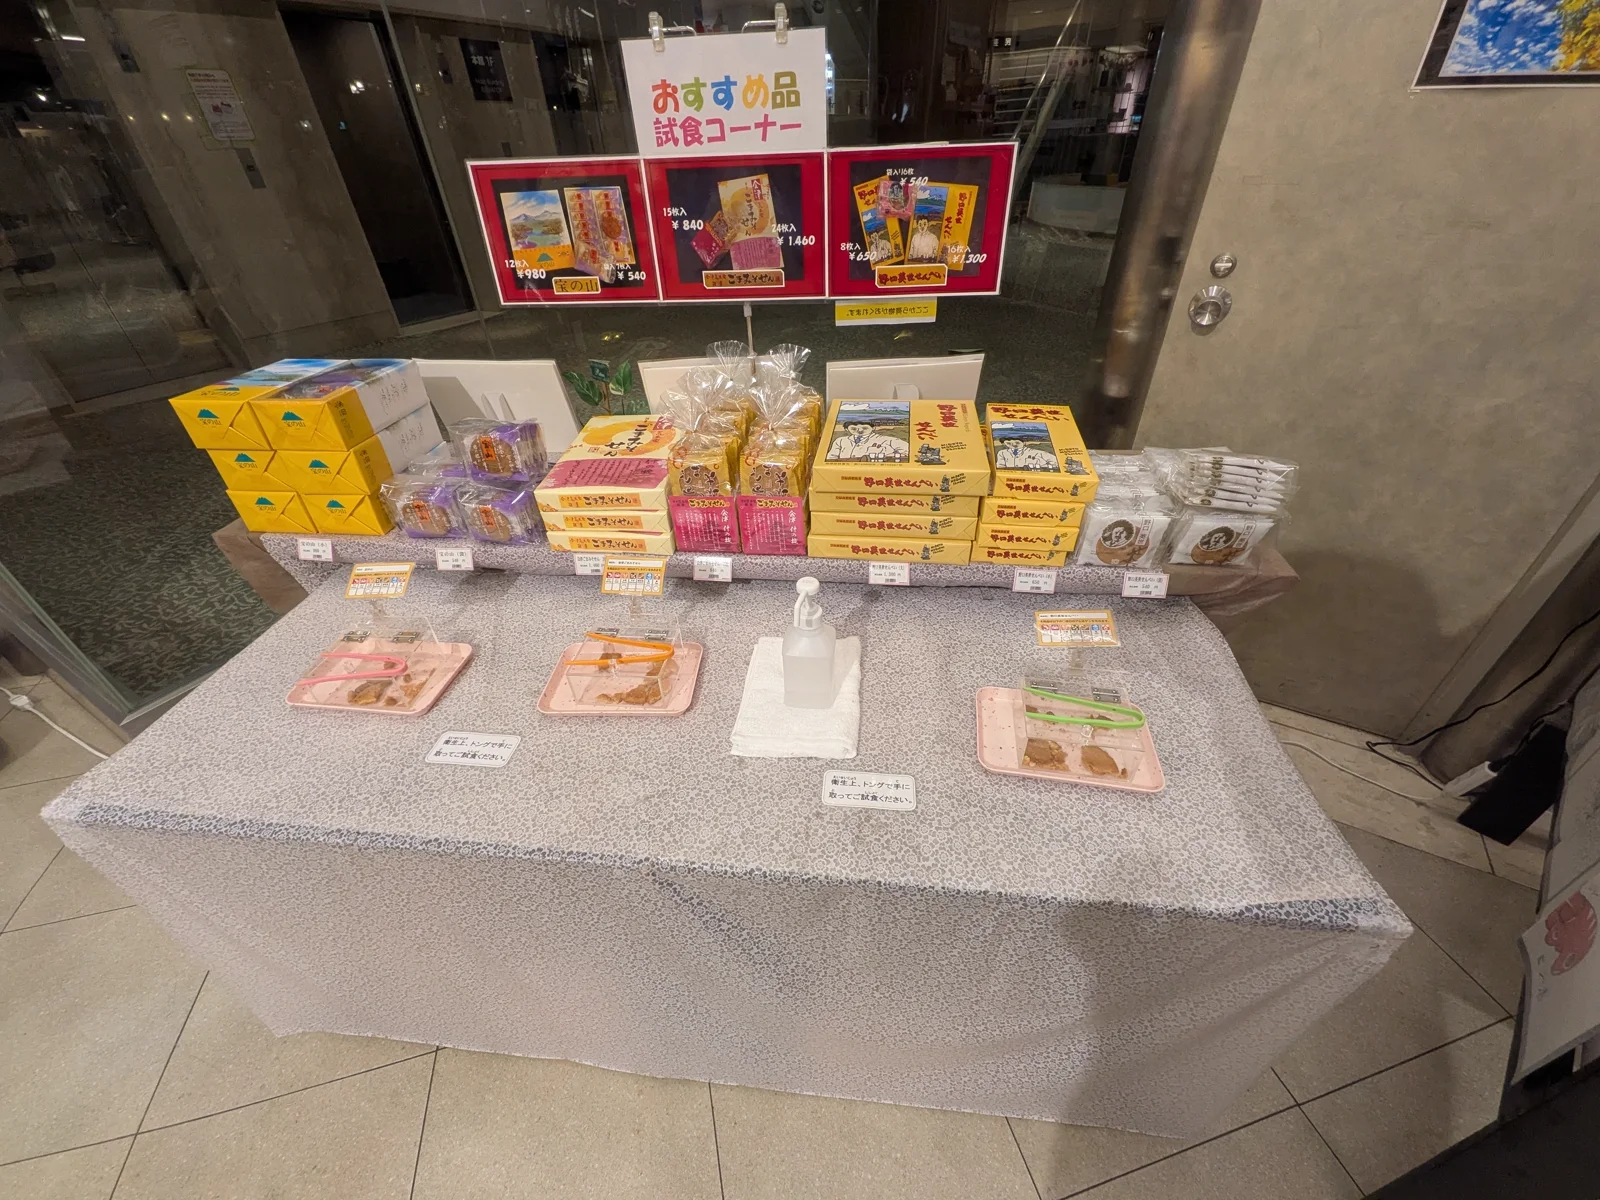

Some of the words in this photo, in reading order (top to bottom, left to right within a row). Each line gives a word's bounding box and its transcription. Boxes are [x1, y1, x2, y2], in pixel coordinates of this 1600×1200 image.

[651, 71, 801, 115] おすすめ品
[653, 113, 802, 148] 試食コーナー
[663, 207, 688, 217] 15枚入
[771, 223, 797, 233] 24枚入
[840, 242, 861, 251] 8枚入
[947, 245, 972, 253] 16枚入
[878, 271, 946, 285] 野口英世せんべい
[555, 279, 599, 293] 宝の山
[991, 406, 1064, 416] 野口英世
[863, 476, 939, 489] 野口英世せんべい
[1005, 482, 1069, 493] 野口英世せんべい
[857, 496, 929, 508] 野口英世せんべい
[996, 509, 1059, 520] 野口英世せんべい
[857, 519, 928, 531] 野口英世せんべい
[990, 533, 1052, 544] 野口英世せんべい
[851, 544, 920, 556] 野口英世せんべい
[987, 550, 1046, 560] 野口英世せんべい
[831, 778, 911, 791] 衛生上、トングで手に
[828, 790, 913, 804] 取ってご試食ください。
